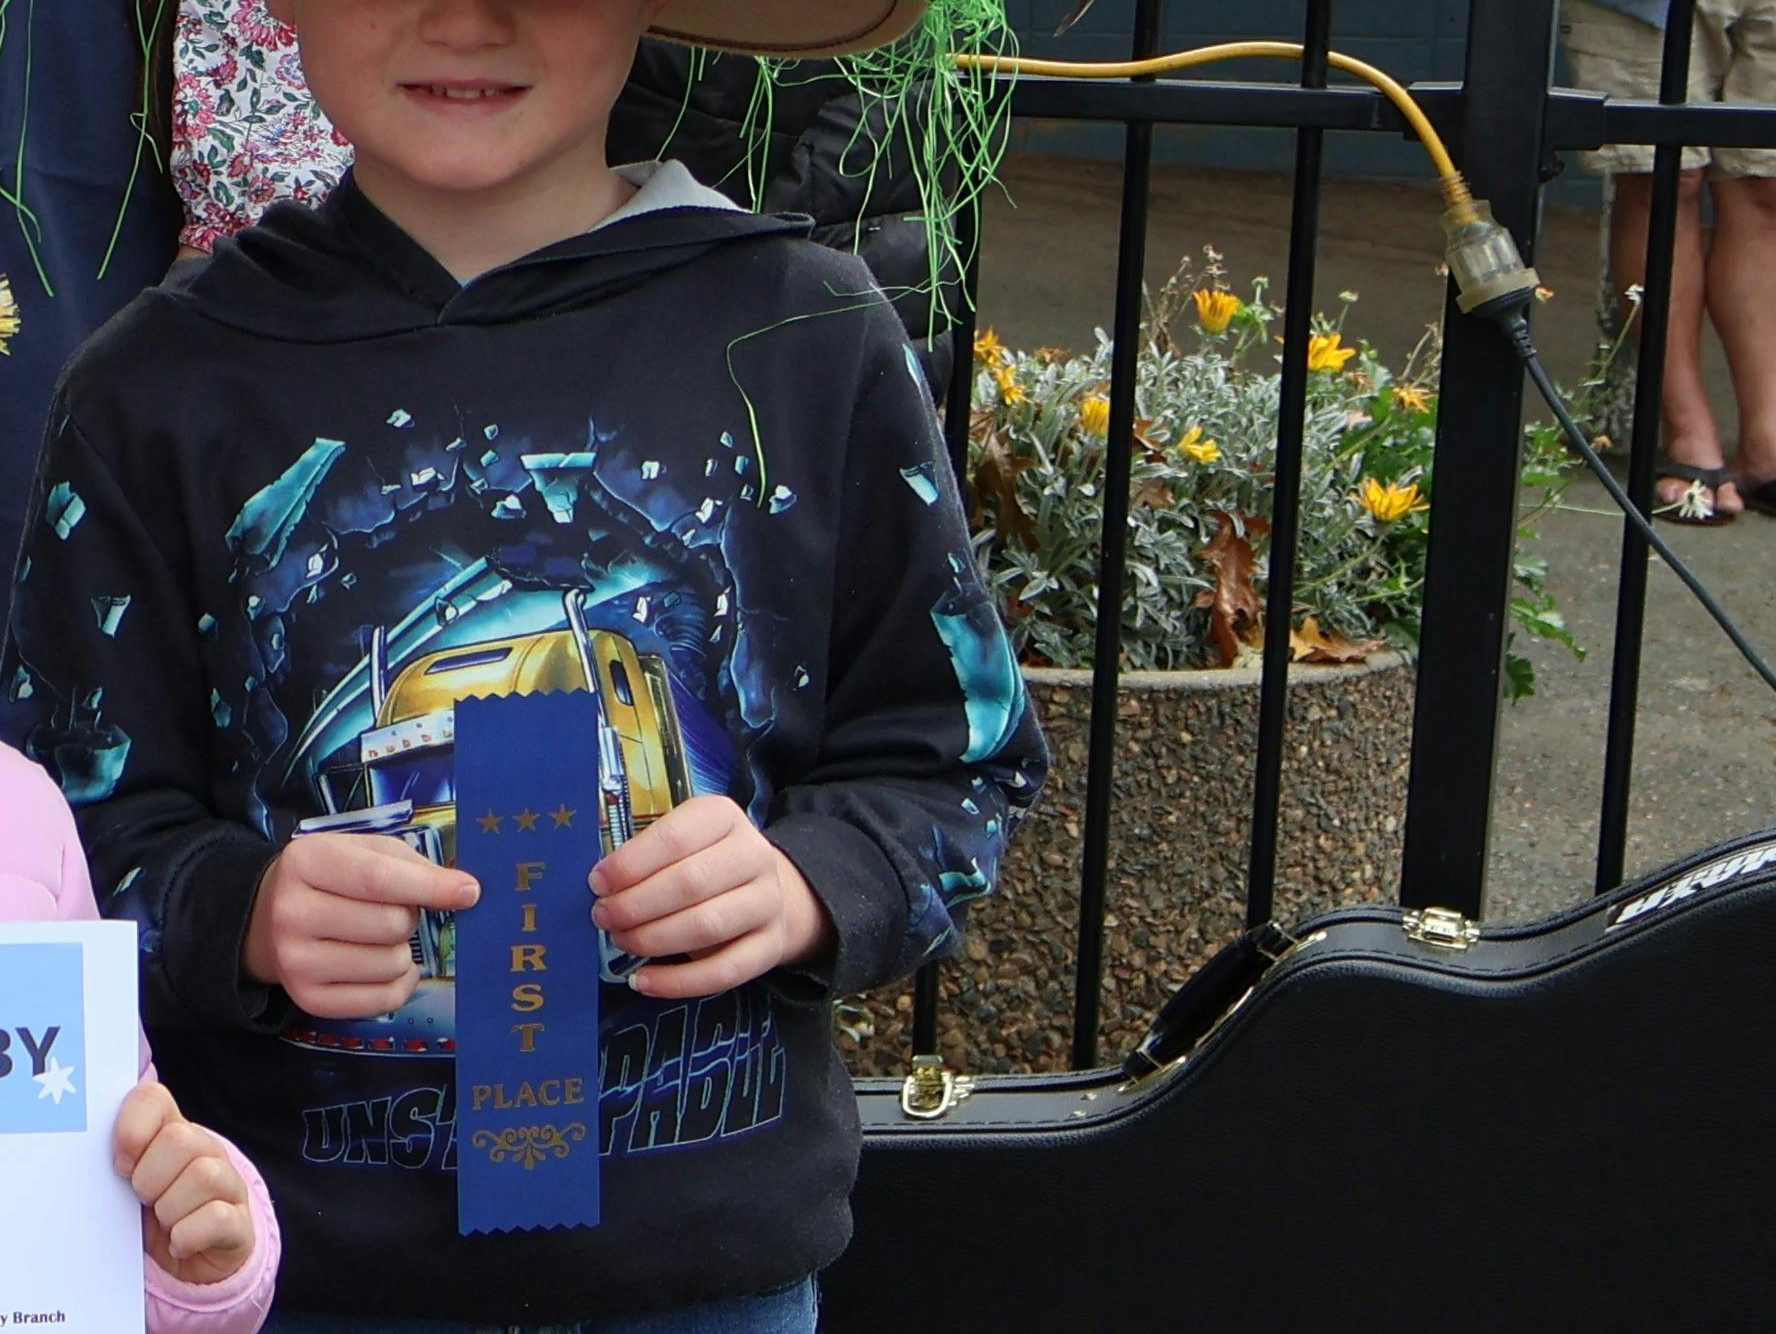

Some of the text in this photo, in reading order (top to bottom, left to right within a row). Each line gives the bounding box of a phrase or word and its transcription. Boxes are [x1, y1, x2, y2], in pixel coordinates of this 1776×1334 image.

[510, 861, 547, 1053] FIRST
[471, 1077, 584, 1111] PLACE
[13, 1310, 66, 1325] Branch
